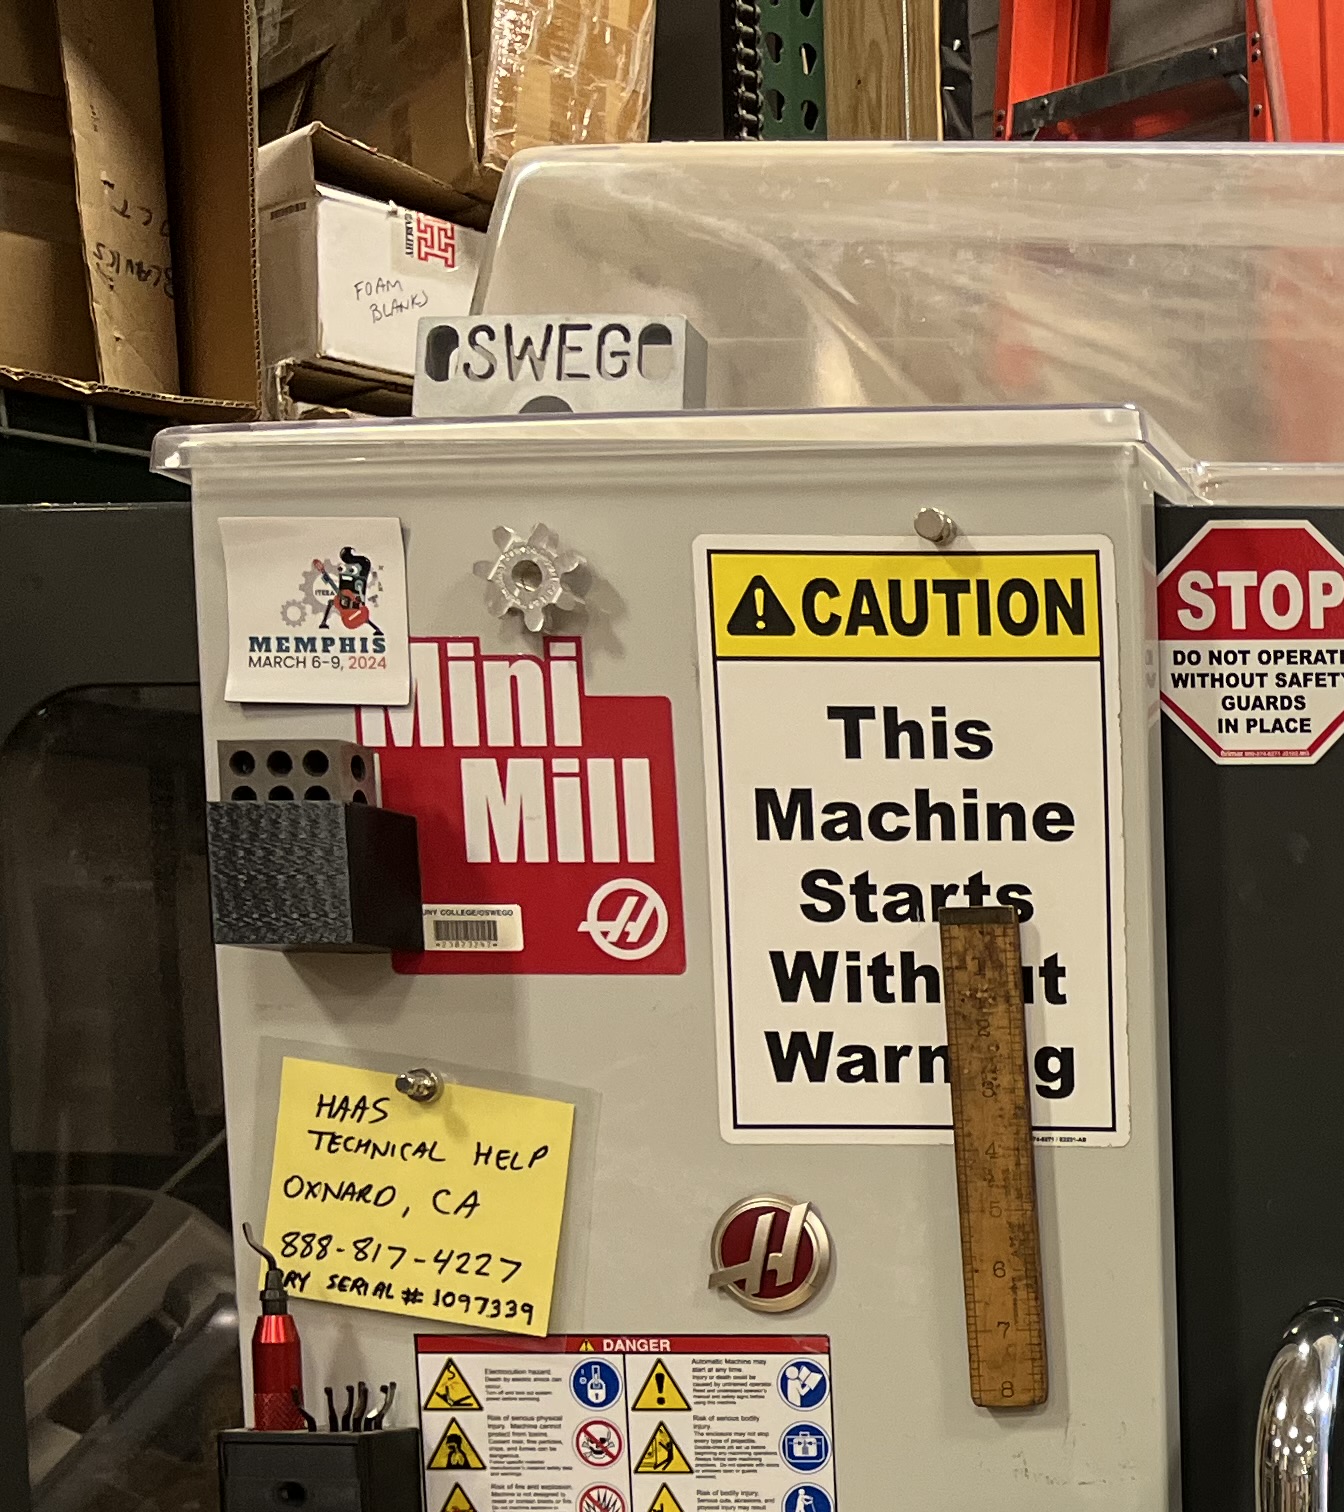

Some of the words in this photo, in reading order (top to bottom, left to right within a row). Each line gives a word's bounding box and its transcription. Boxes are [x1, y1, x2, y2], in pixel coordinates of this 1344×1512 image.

[355, 277, 403, 301] FOAM
[801, 579, 1085, 638] CAUTION
[249, 636, 386, 654] MEMPHIS
[1173, 650, 1201, 665] DO
[1208, 650, 1250, 665] NOT
[248, 655, 307, 669] MARCH
[311, 655, 344, 671] 6-9,
[348, 655, 387, 670] 2024
[1171, 673, 1268, 688] WITHOUT
[361, 642, 582, 747] Mini
[1221, 695, 1306, 711] GUARDS
[827, 705, 994, 761] This
[1217, 718, 1239, 733] IN
[1246, 718, 1312, 733] PLACE
[460, 758, 655, 863] Mill
[755, 788, 1075, 843] Machine
[800, 869, 1034, 924] Starts
[771, 949, 1067, 1007] Witht
[764, 1031, 1075, 1099] Warng
[316, 1093, 390, 1125] HAAS
[308, 1129, 446, 1163] TECHNICAL
[473, 1145, 549, 1171] HELP
[984, 1142, 996, 1158] 4
[432, 1189, 481, 1220] CA
[989, 1202, 1002, 1217] 5
[280, 1232, 523, 1284] 888-817-4227
[993, 1261, 1006, 1278] 6
[326, 1273, 394, 1300] SERIAL
[432, 1288, 534, 1326] 1097339
[997, 1321, 1010, 1339] 7
[602, 1339, 671, 1353] DANGER
[1001, 1381, 1015, 1399] 8
